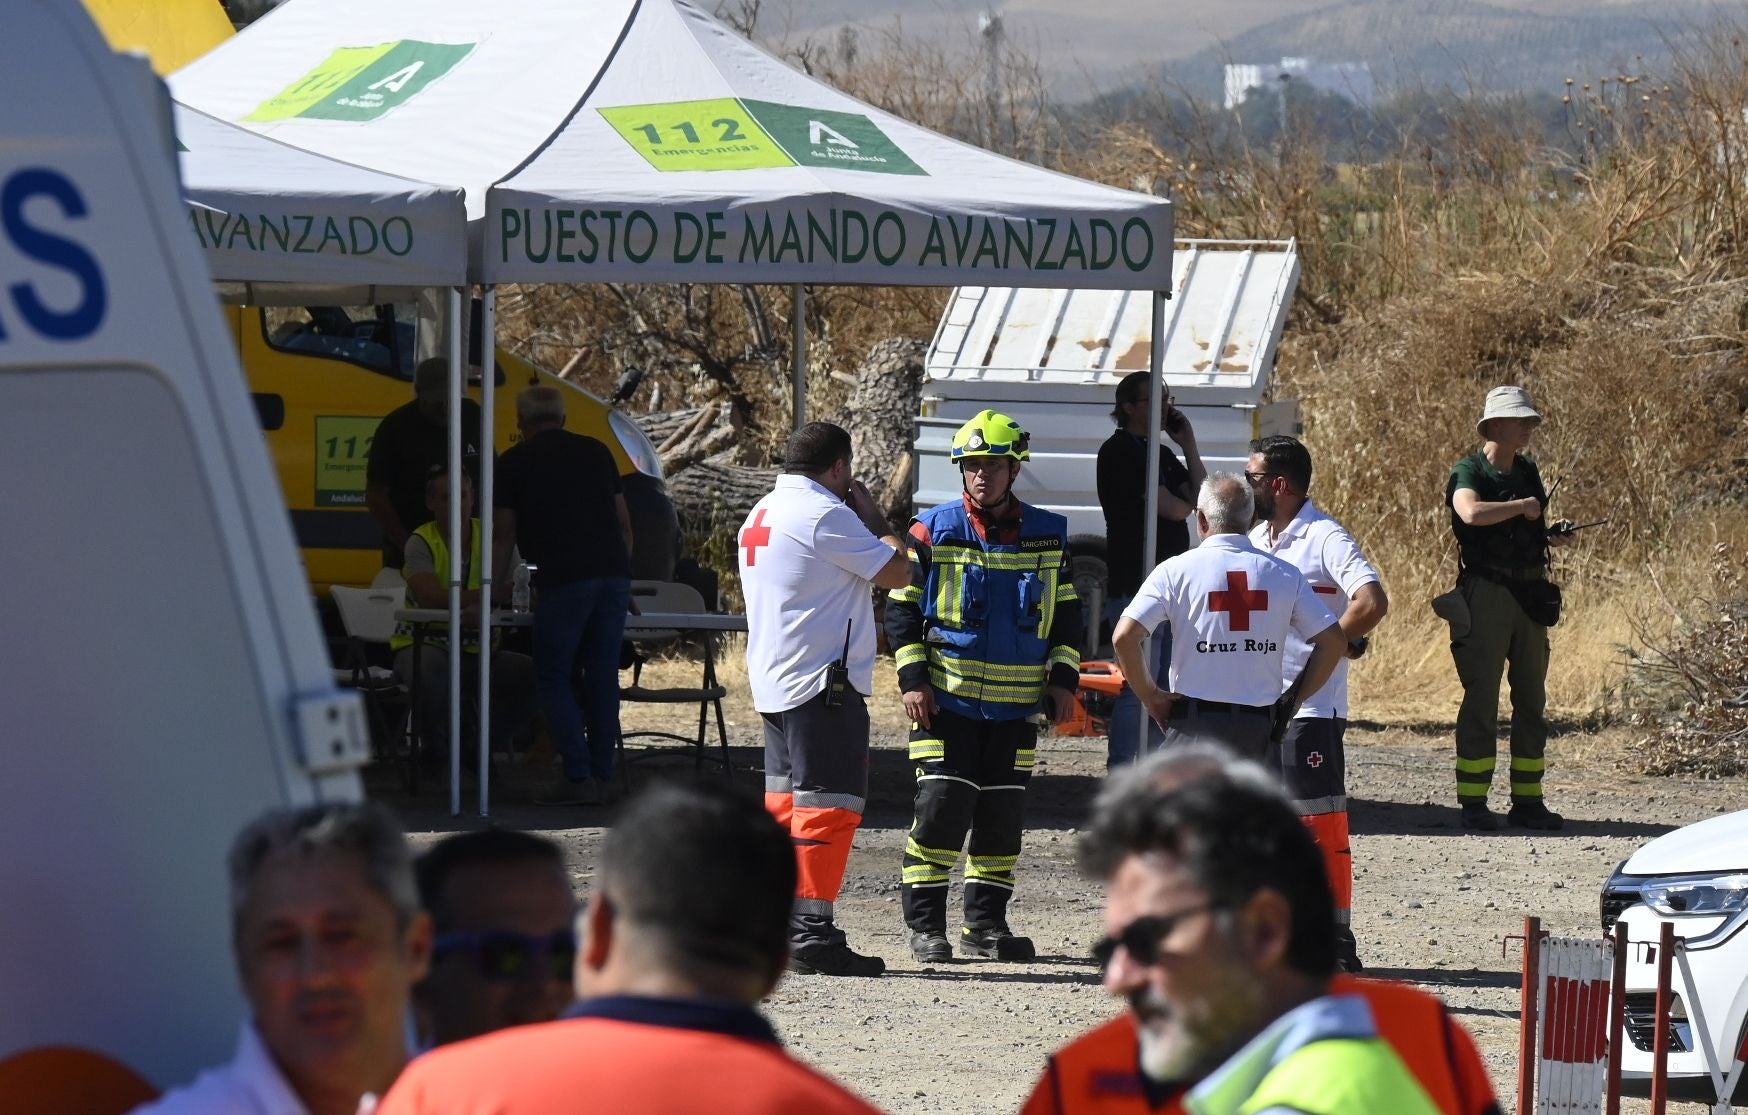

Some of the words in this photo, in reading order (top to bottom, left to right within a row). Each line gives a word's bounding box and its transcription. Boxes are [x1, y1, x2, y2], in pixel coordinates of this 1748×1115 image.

[633, 118, 746, 145] 112
[652, 144, 759, 157] Emergencias
[502, 208, 658, 264] PUESTO
[674, 211, 724, 264] DE
[739, 208, 906, 267] MANDO
[917, 214, 1154, 272] AVANZADO
[324, 463, 366, 472] Emergenc
[330, 493, 367, 503] Andalucí
[1021, 539, 1059, 548] SARGENTO
[1196, 640, 1237, 653] Cruz
[1244, 639, 1277, 654] Roja
